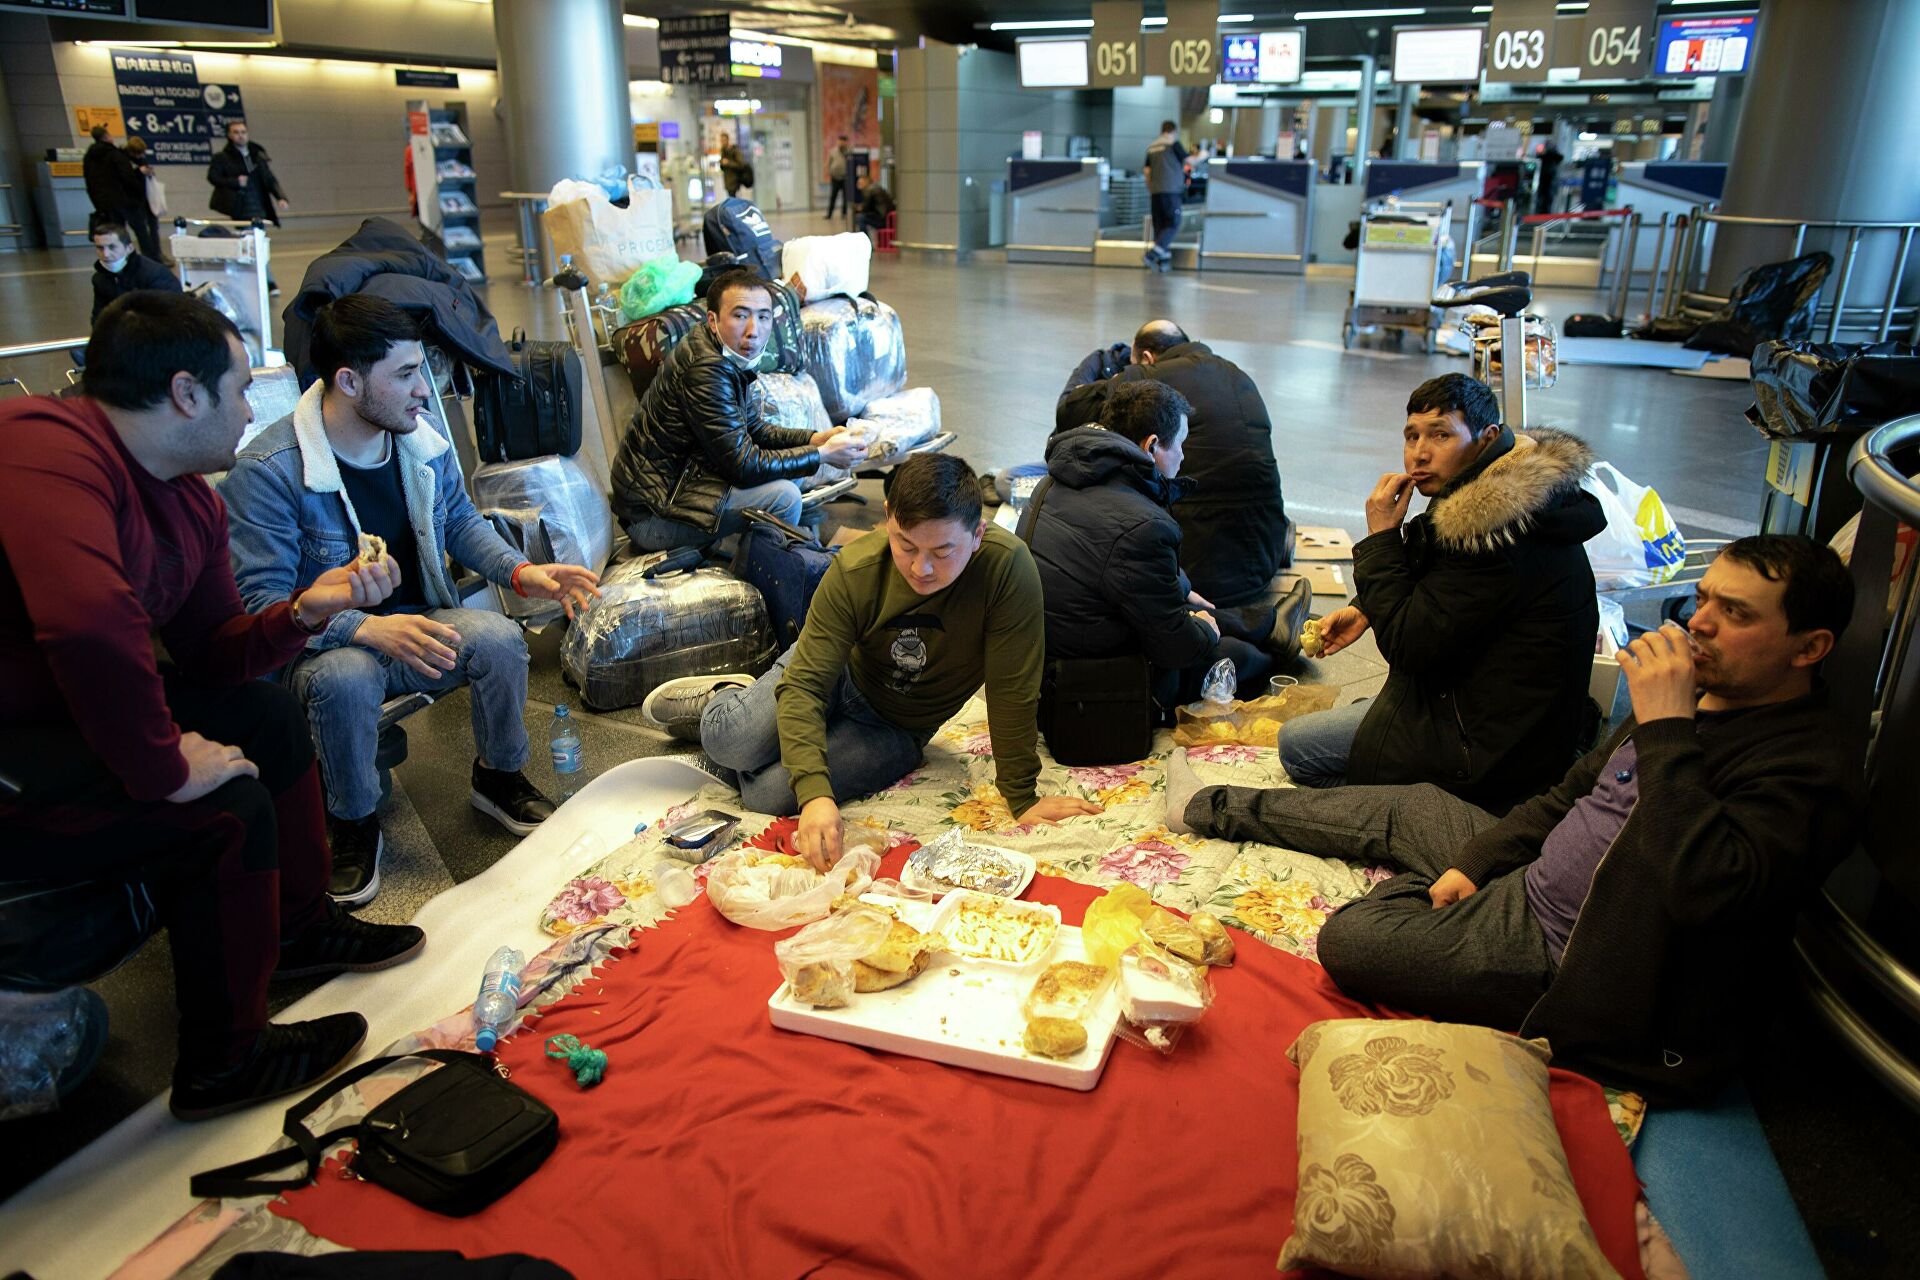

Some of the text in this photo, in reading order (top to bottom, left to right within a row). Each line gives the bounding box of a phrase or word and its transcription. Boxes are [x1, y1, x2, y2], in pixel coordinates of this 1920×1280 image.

[1096, 41, 1137, 76] 051
[1170, 39, 1212, 75] 052
[1493, 30, 1545, 70] 053
[1589, 25, 1642, 66] 054
